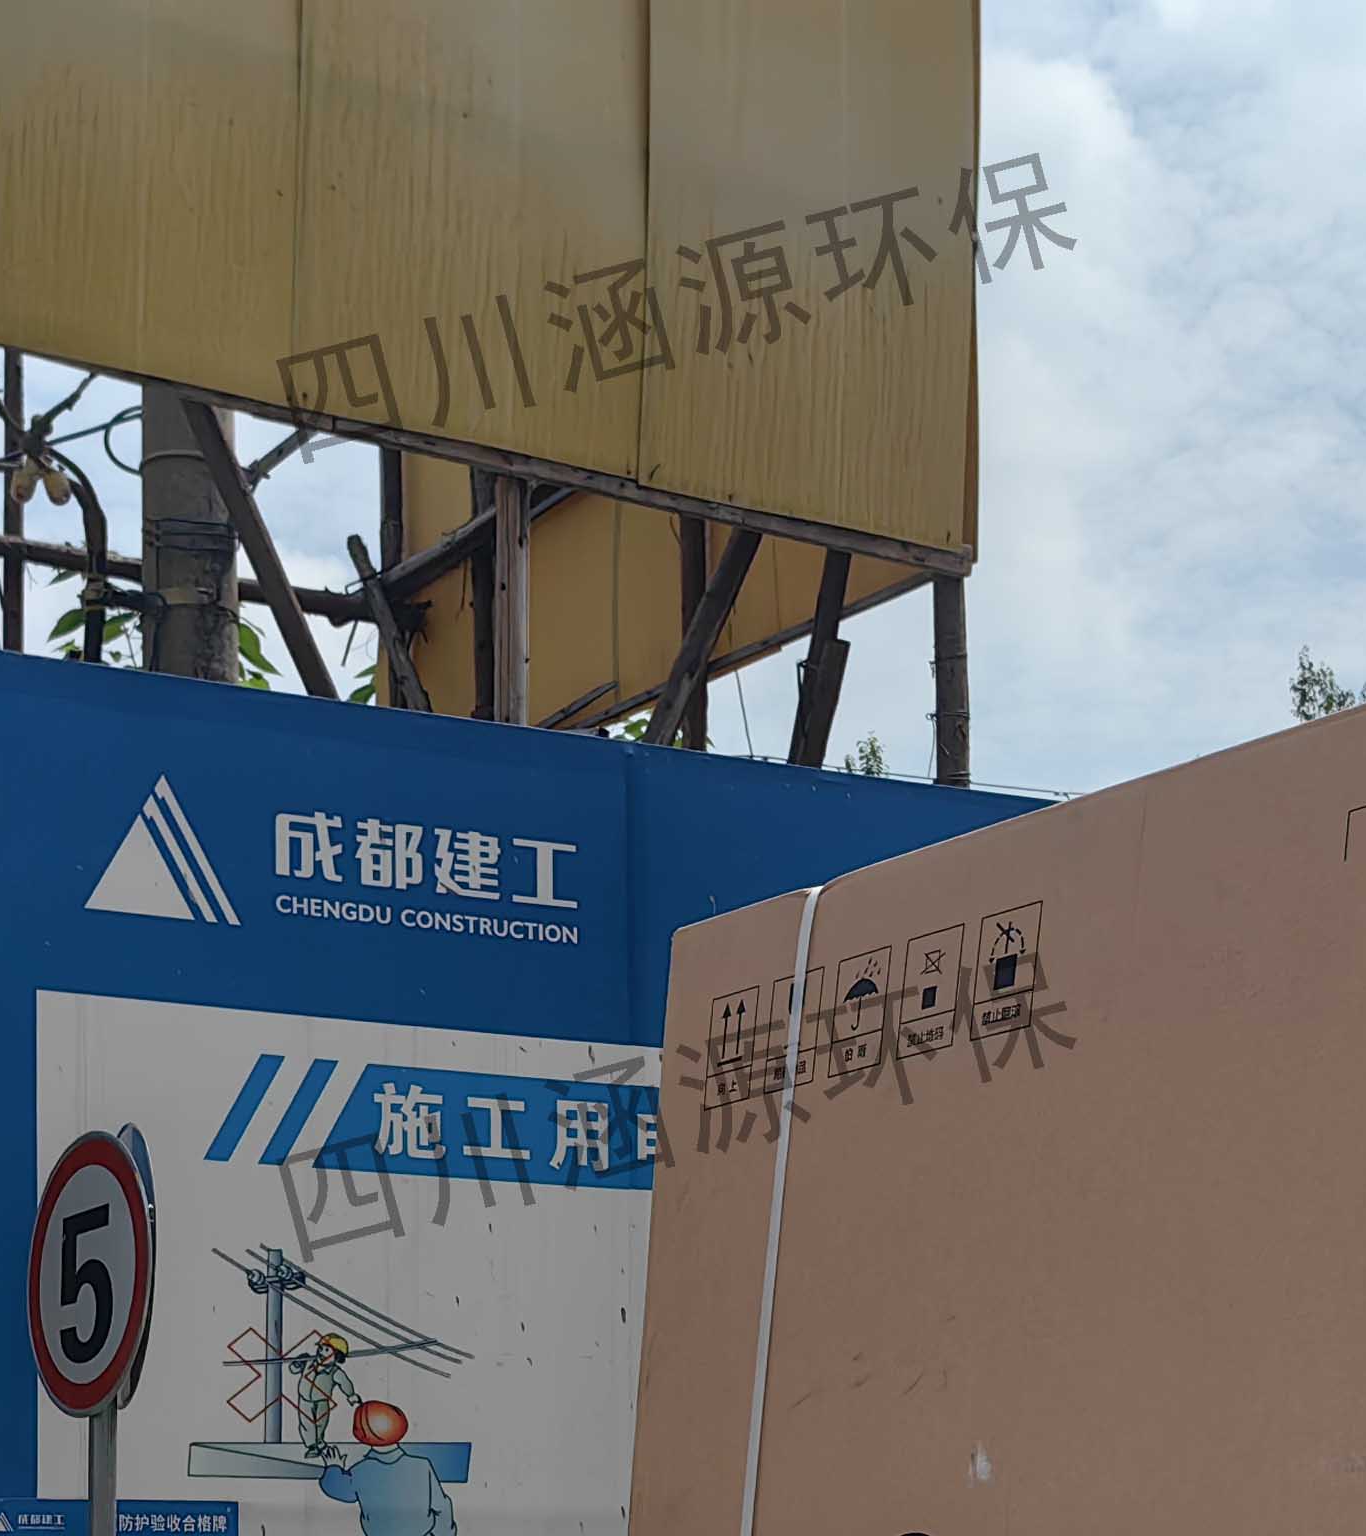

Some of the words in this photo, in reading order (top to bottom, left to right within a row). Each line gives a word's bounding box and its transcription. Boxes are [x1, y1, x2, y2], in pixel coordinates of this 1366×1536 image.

[275, 811, 579, 909] 成都建工
[275, 894, 392, 926] CHENGDU
[400, 906, 579, 945] CONSTRUCTION
[60, 1203, 112, 1365] 5
[18, 1514, 66, 1527] 成都建工
[118, 1514, 228, 1534] 防护验收合格牌
